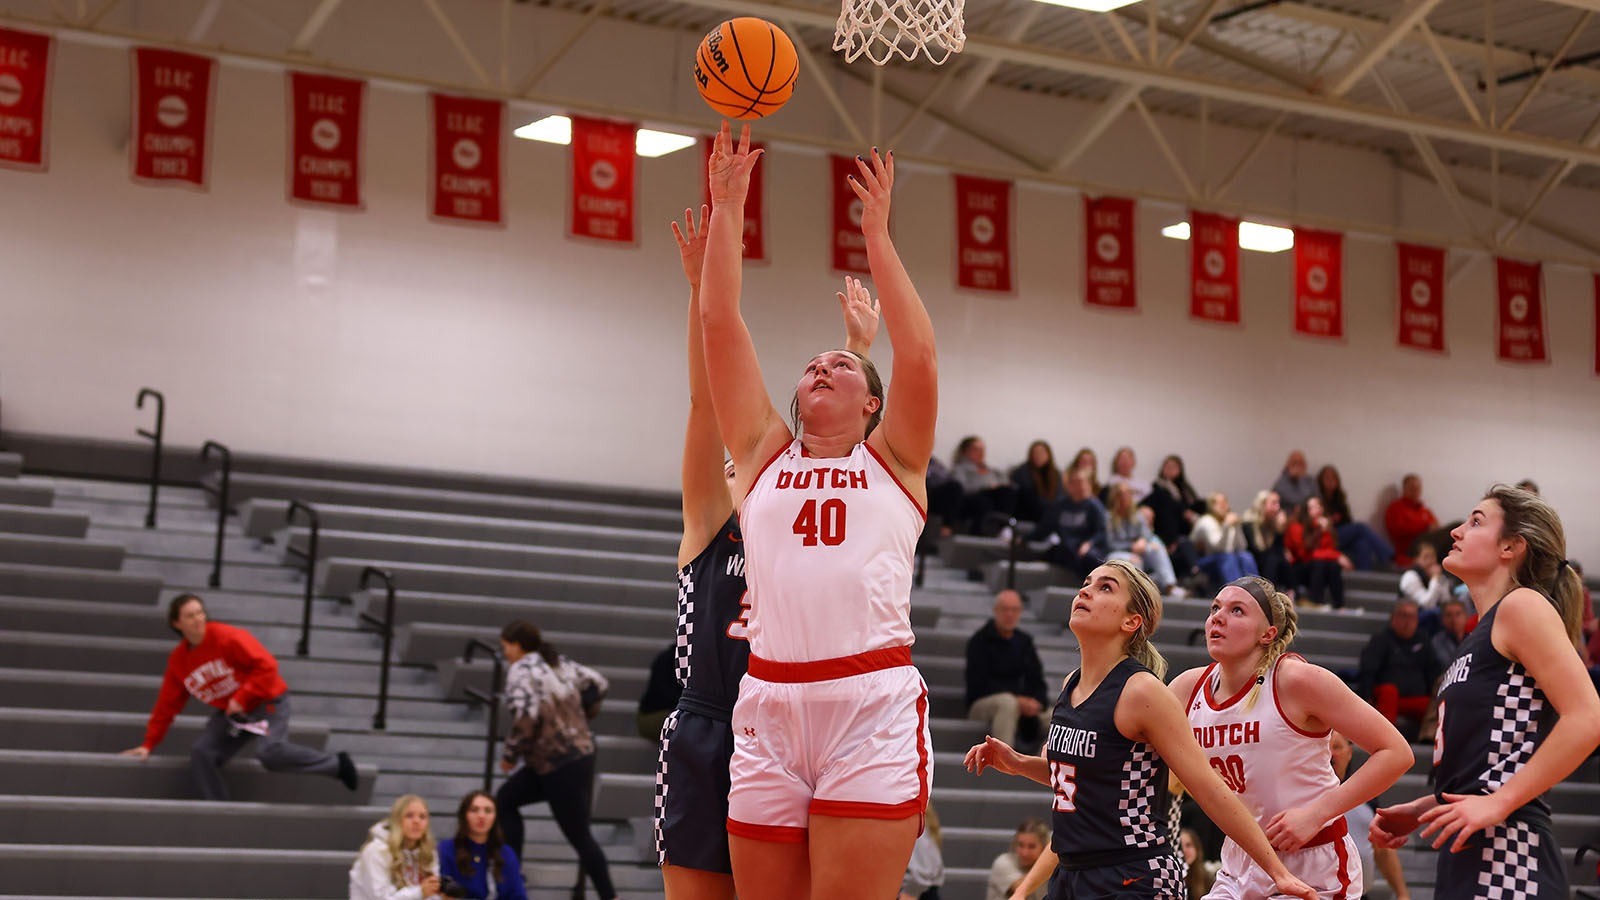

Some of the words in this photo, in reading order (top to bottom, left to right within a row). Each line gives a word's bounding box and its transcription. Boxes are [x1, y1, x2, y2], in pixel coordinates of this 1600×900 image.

[154, 67, 193, 89] IIAC
[144, 133, 195, 156] CHAMPS
[300, 155, 351, 178] CHAMPS
[440, 173, 492, 196] CHAMPS
[578, 195, 627, 217] CHAMPS
[962, 248, 1004, 269] CHAMPS
[1089, 266, 1129, 284] CHAMPS
[775, 467, 869, 490] DUTCH
[792, 498, 847, 547] 40
[1193, 721, 1260, 749] DUTCH
